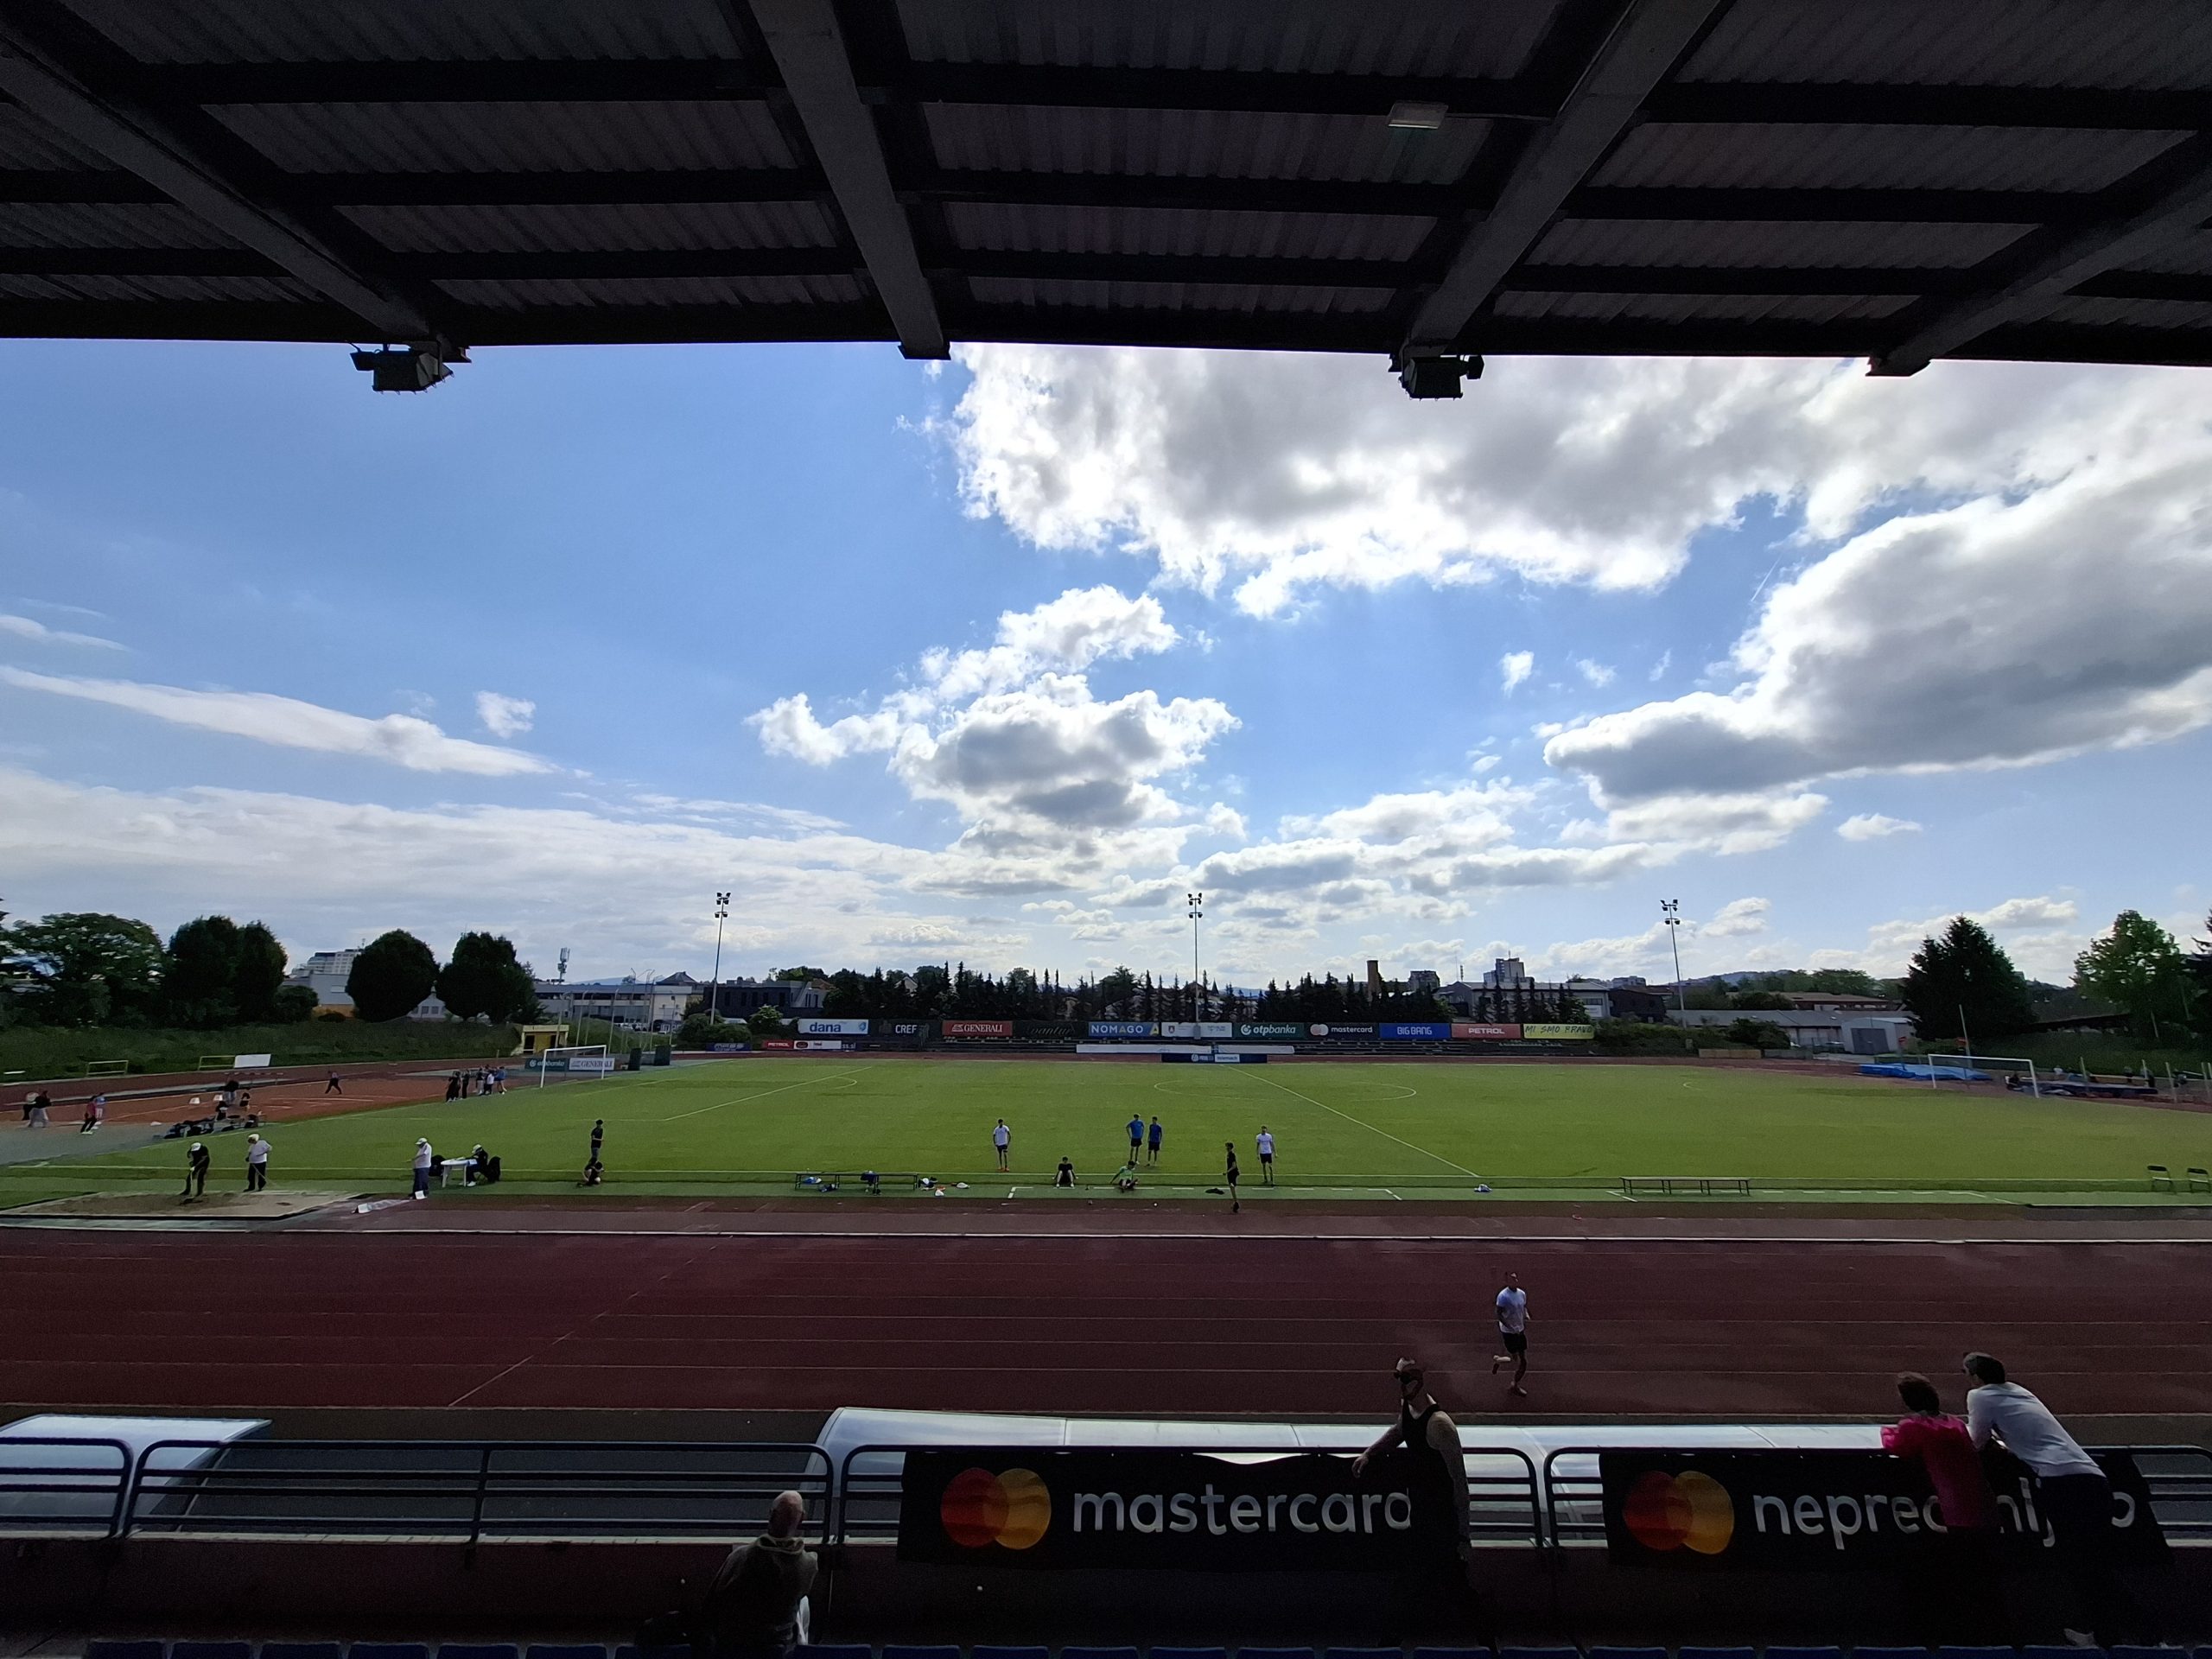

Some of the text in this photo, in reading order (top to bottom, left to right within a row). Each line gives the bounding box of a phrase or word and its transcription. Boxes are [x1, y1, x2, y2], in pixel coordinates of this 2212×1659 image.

[809, 1022, 842, 1033] dana
[894, 1024, 917, 1034] CREF
[963, 1024, 1003, 1033] GENERALI
[1090, 1025, 1143, 1034] NOMAGO
[1253, 1025, 1296, 1036] otpbanka
[1396, 1027, 1433, 1035] BIG BANG
[1073, 1484, 1411, 1535] mastercard
